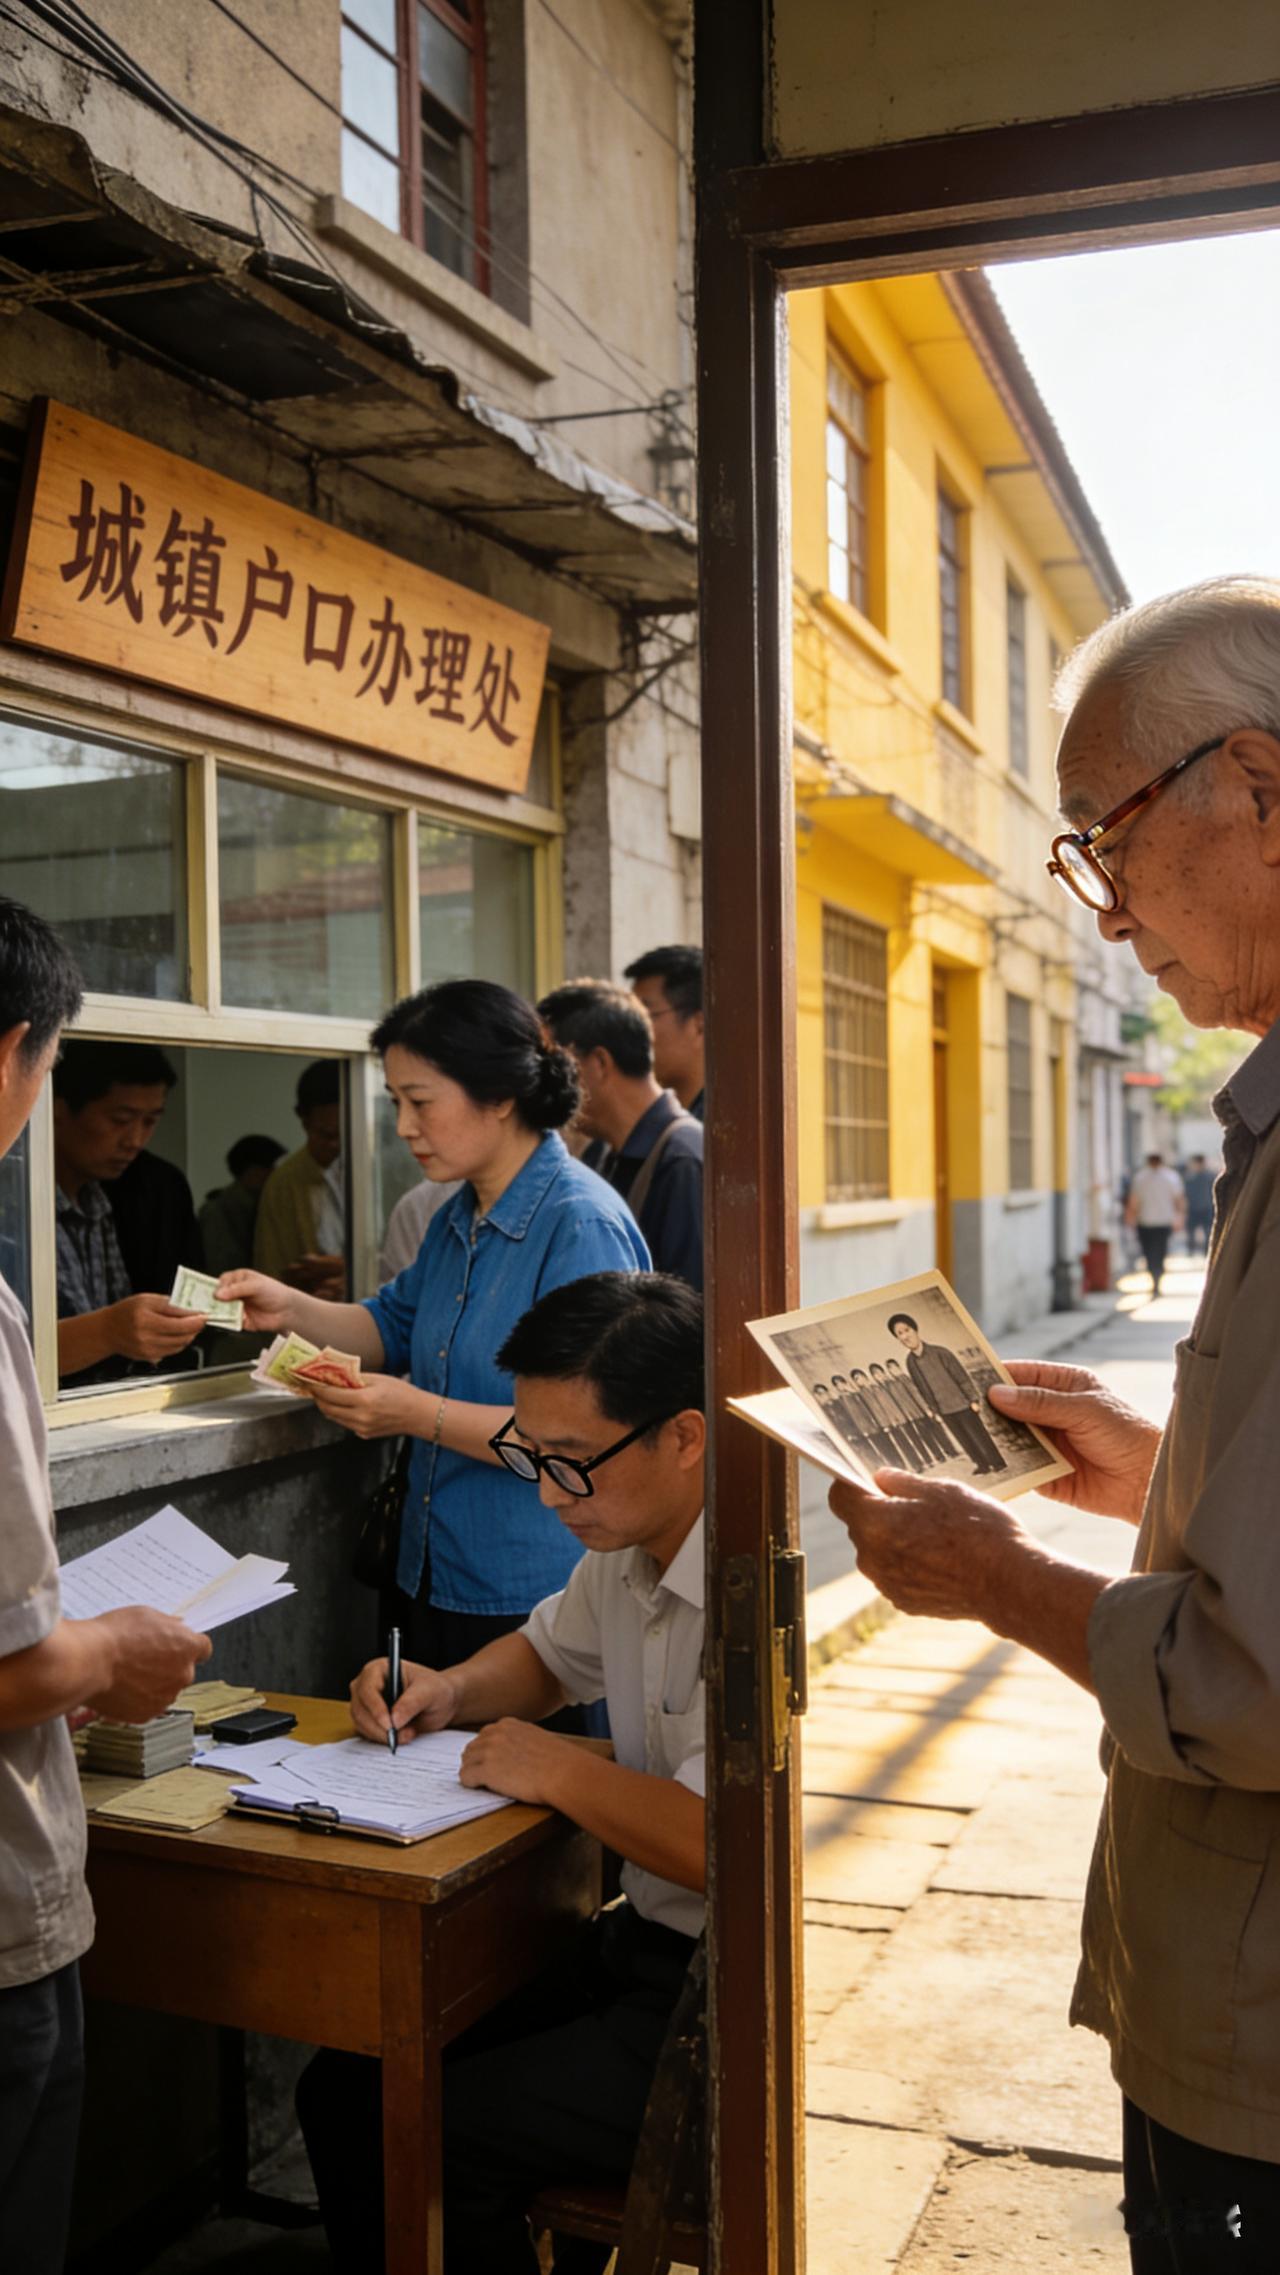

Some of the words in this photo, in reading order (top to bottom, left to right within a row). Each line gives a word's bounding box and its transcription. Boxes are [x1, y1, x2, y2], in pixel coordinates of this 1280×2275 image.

[60, 479, 521, 747] 城镇户口办理处
